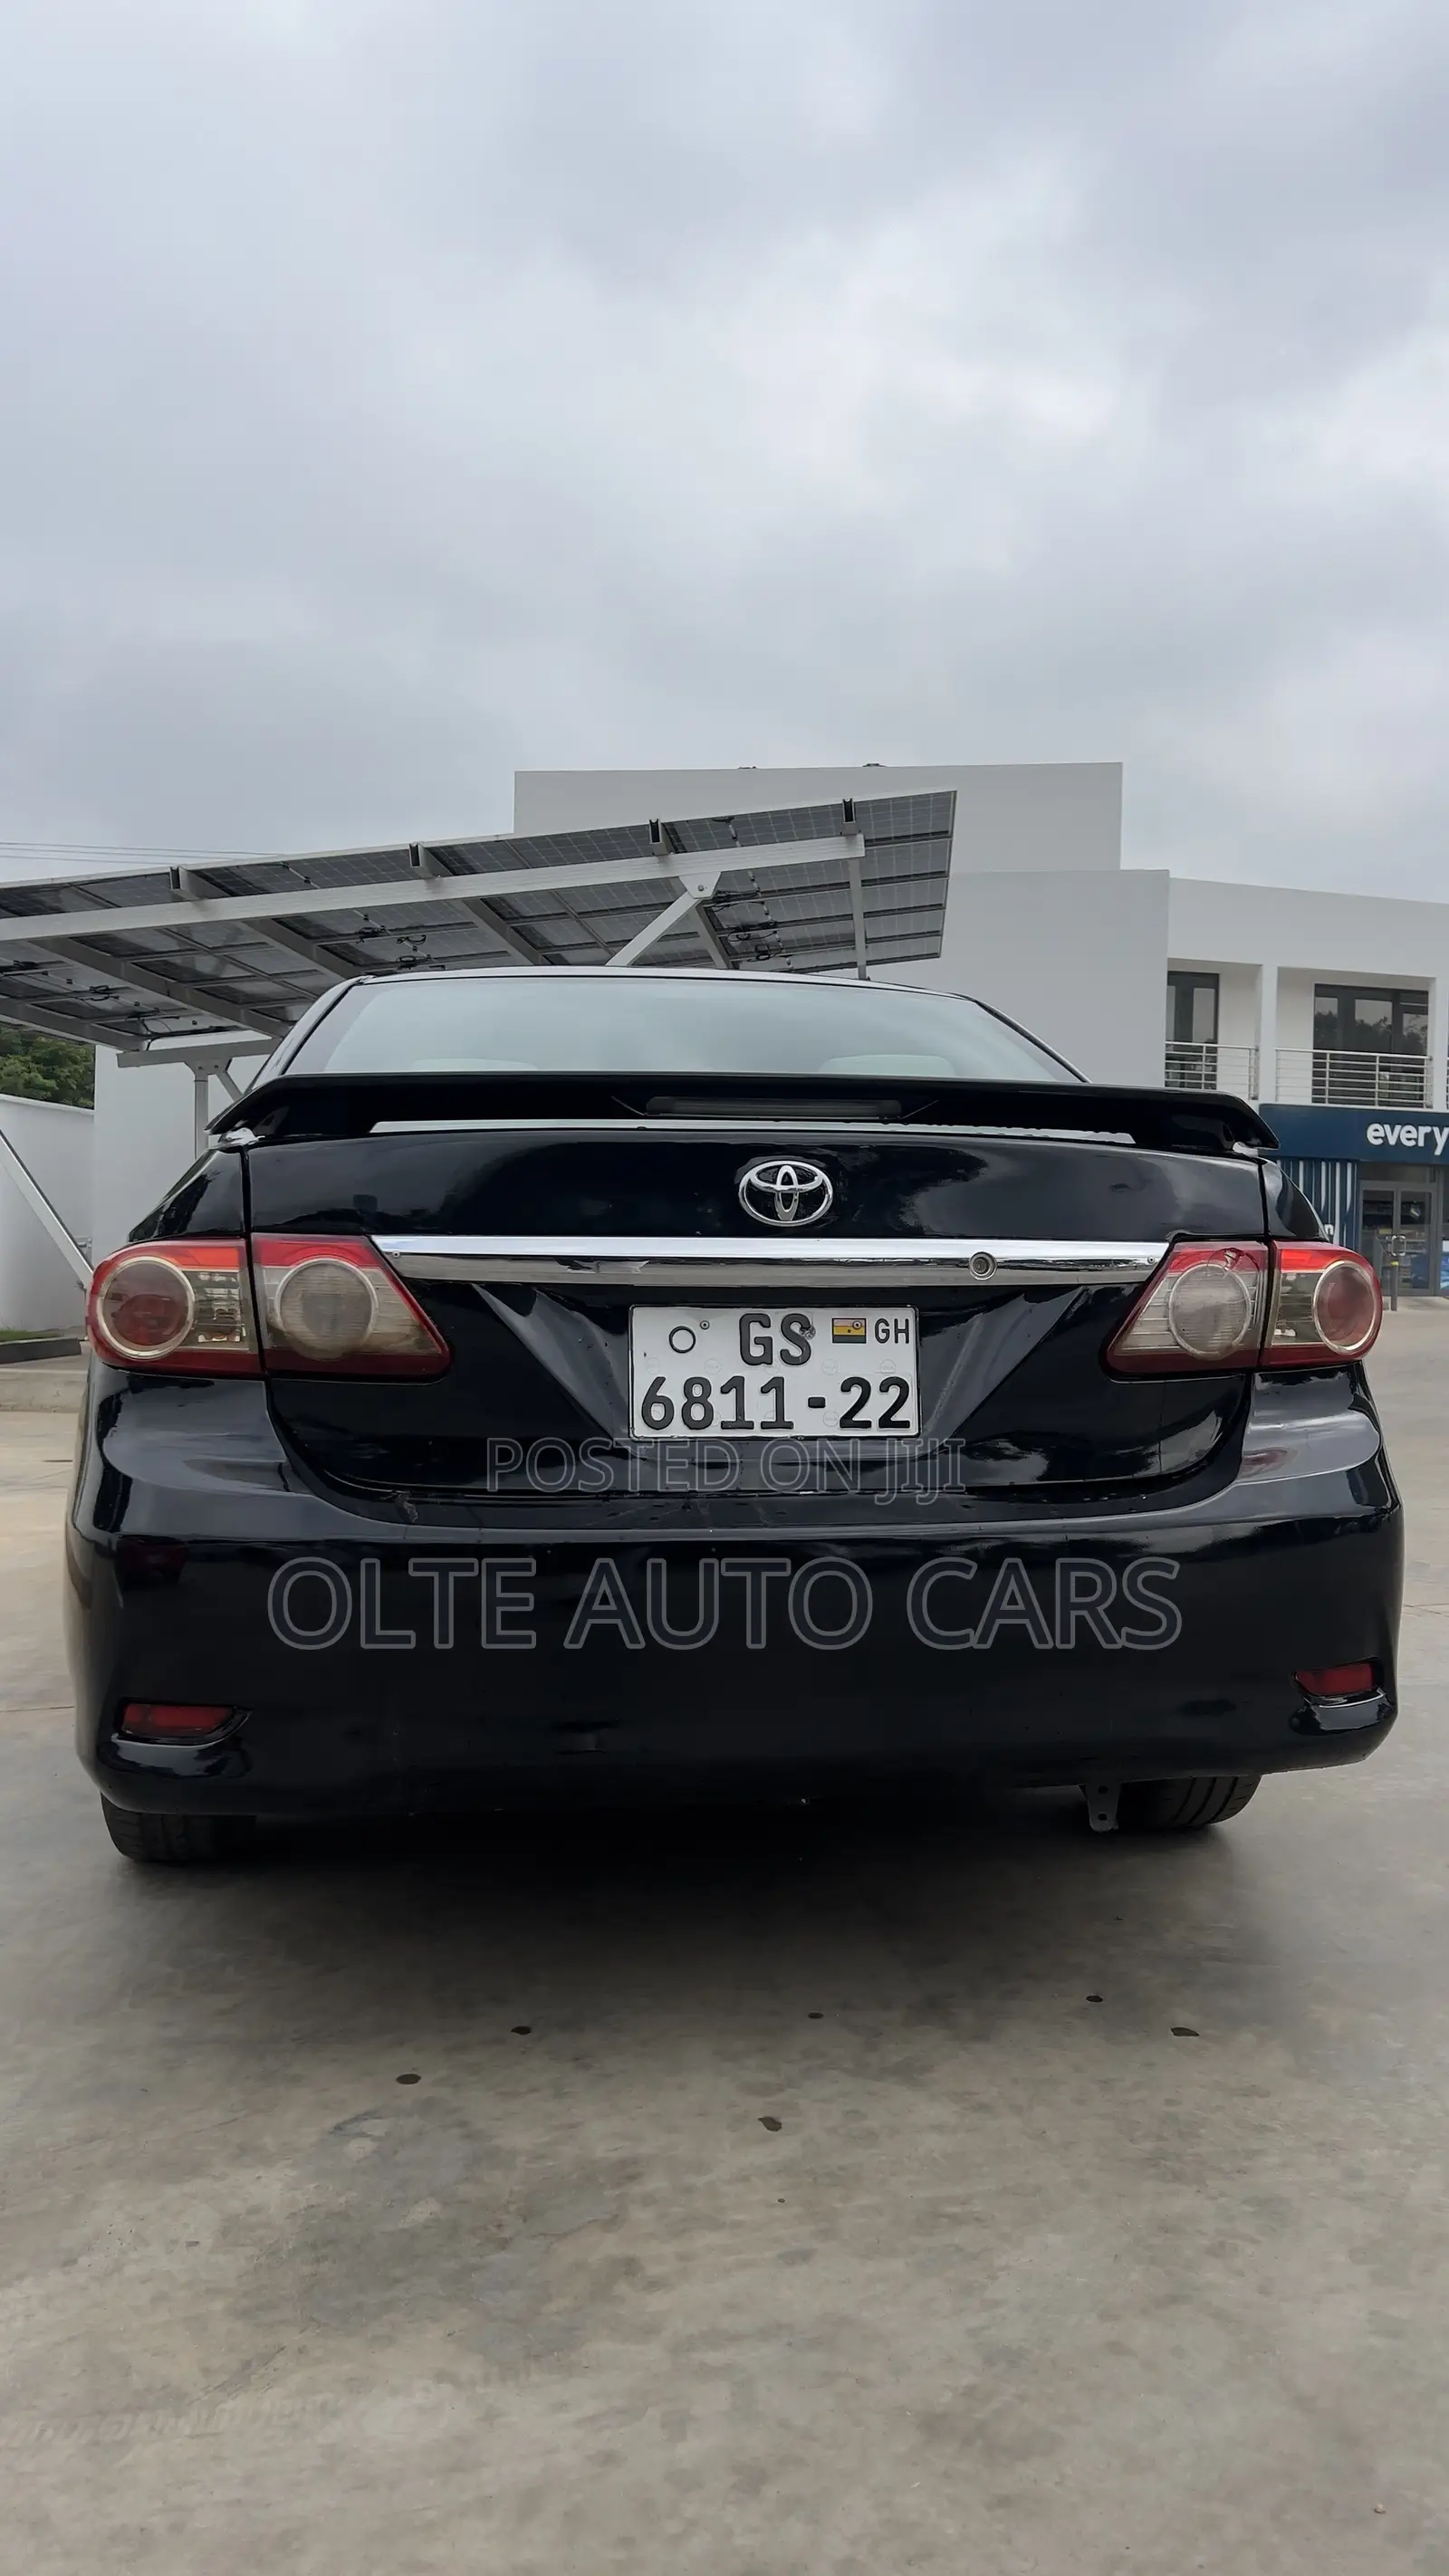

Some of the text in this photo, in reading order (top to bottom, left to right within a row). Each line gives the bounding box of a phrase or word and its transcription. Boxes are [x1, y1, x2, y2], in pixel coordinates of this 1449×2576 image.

[1367, 1124, 1449, 1156] every
[739, 1313, 811, 1365] GS
[874, 1318, 909, 1344] GH
[641, 1375, 911, 1431] 6811-22
